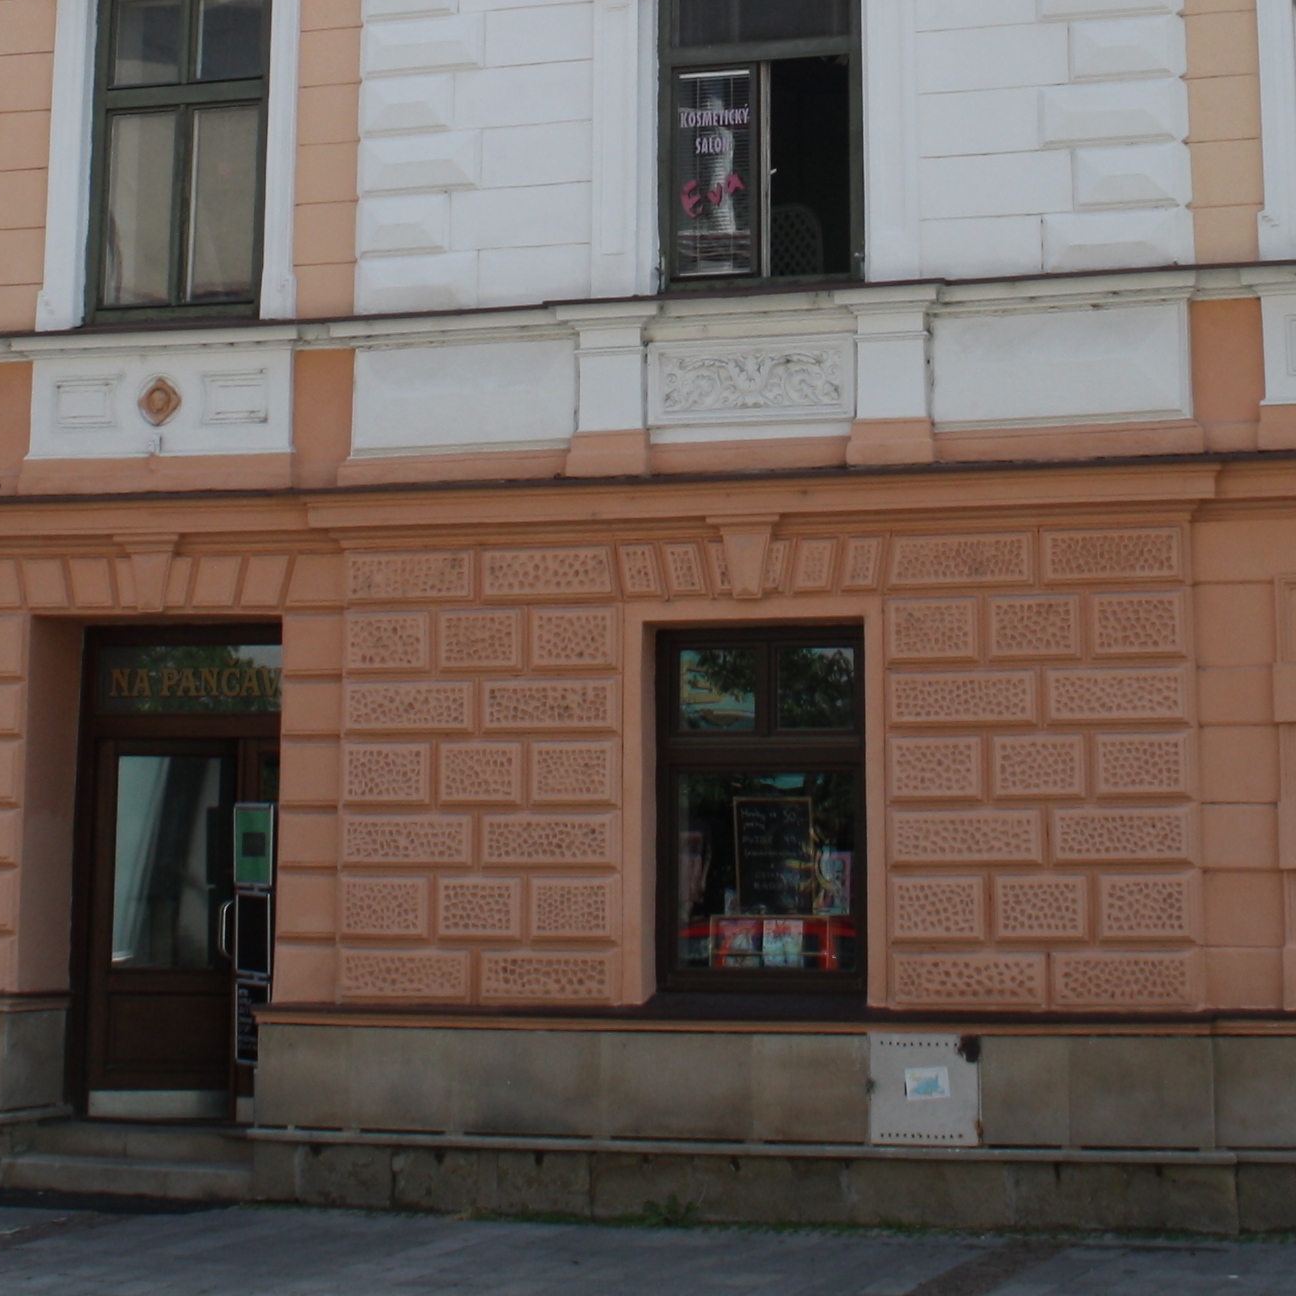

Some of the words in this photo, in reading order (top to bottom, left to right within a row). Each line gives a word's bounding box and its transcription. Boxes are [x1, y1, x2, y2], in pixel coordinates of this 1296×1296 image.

[680, 103, 749, 128] KOSMETICKÝ
[695, 137, 731, 154] SALON
[108, 668, 152, 698] NA
[159, 658, 283, 698] PANČAV
